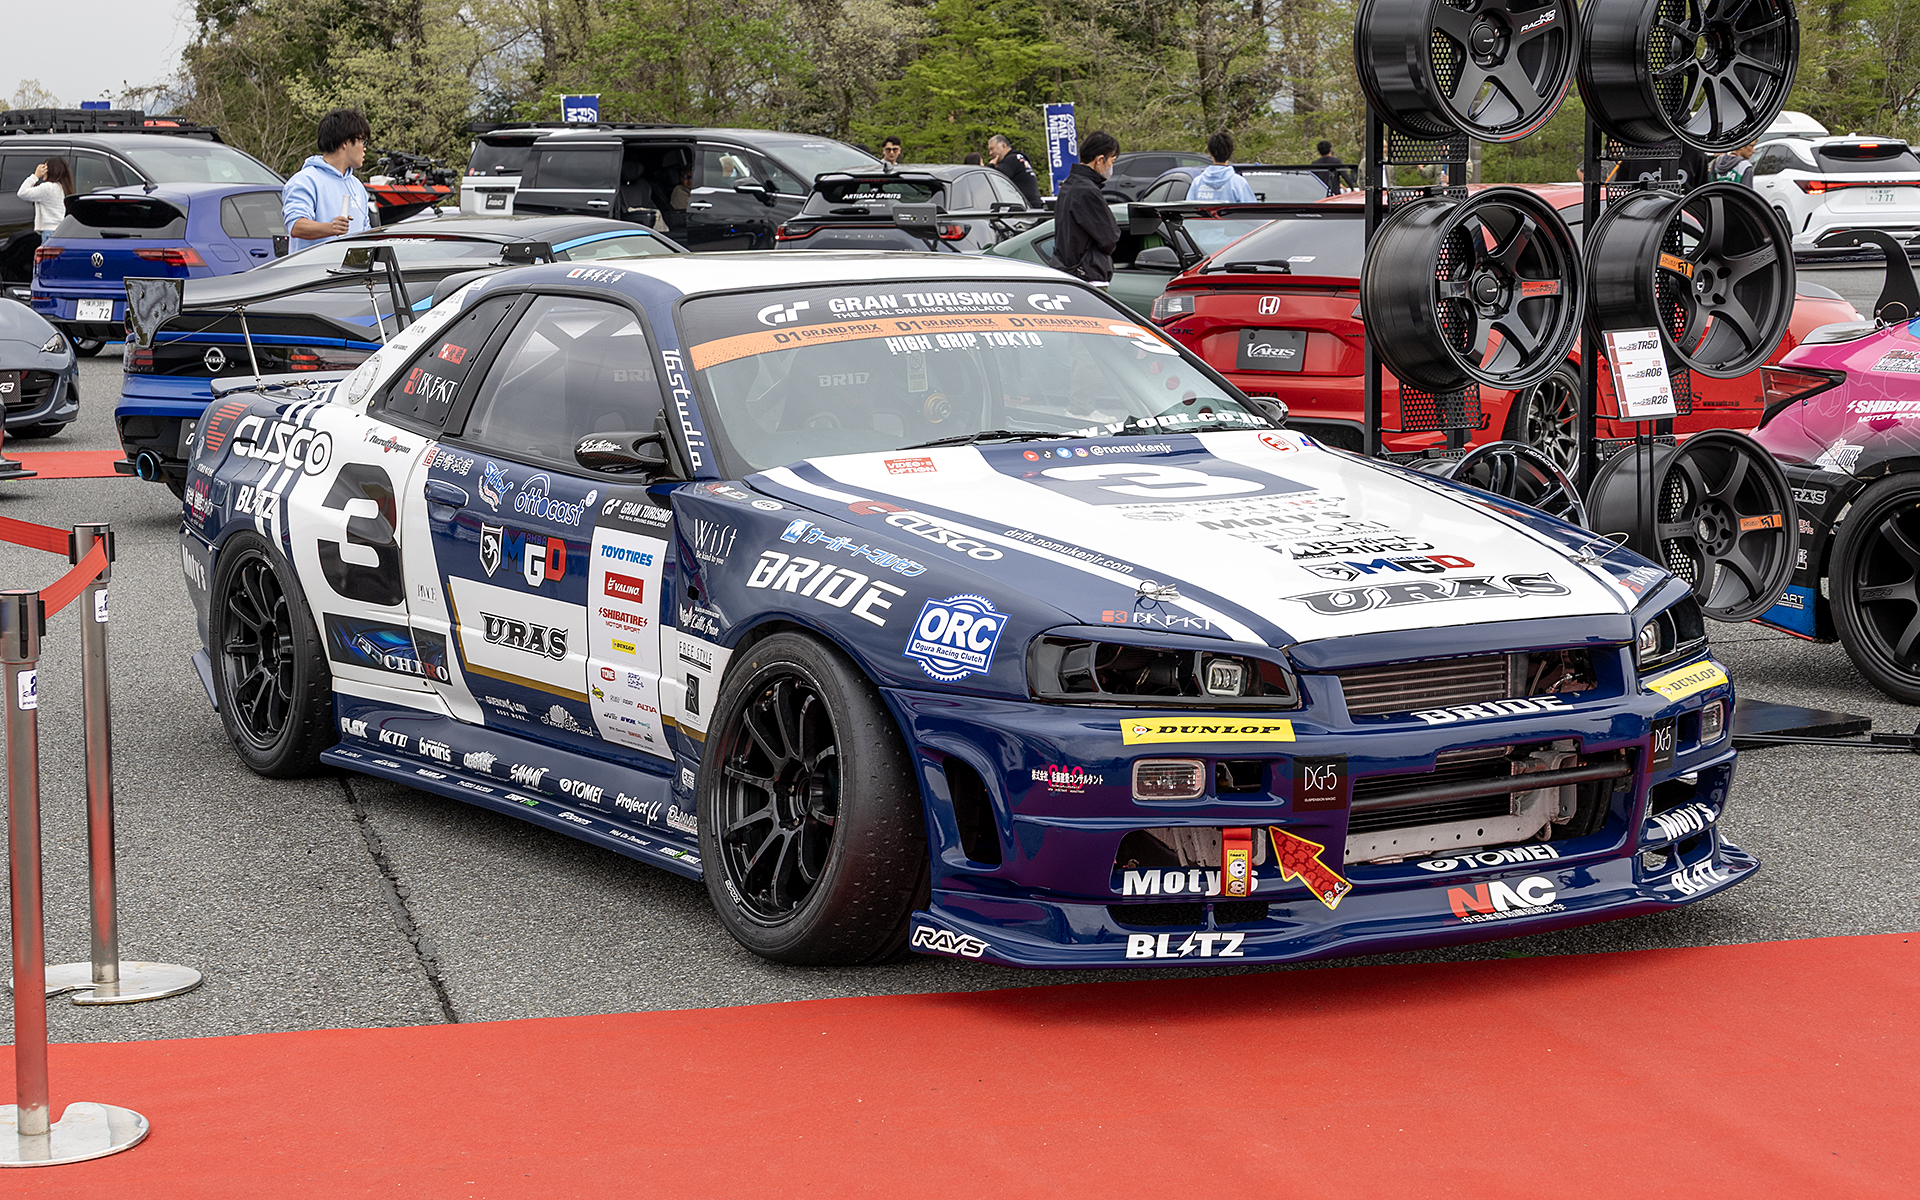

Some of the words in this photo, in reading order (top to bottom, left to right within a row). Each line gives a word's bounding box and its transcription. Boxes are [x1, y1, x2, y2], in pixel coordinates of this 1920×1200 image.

[1058, 114, 1067, 139] FAN
[1066, 112, 1078, 156] RAYS
[1048, 114, 1062, 168] MEETING
[1197, 191, 1214, 199] FAN
[828, 295, 898, 313] GRAN
[901, 291, 1009, 310] TURISMO
[895, 307, 945, 316] DRIVING
[945, 305, 1014, 315] SIMULATOR
[773, 331, 802, 344] D1
[802, 324, 847, 338] GRAND
[847, 322, 881, 333] PRIX
[895, 319, 922, 332] D1
[922, 318, 964, 328] GRAND
[965, 317, 997, 326] PRIX
[1008, 317, 1035, 329] D1
[1034, 317, 1072, 327] GRAND
[1072, 319, 1101, 327] PRIX
[1171, 327, 1194, 335] CIVIC
[884, 335, 934, 353] HIGH
[935, 332, 978, 350] GRIP
[980, 332, 1043, 348] TOKYO
[1246, 342, 1297, 358] VARIS
[1638, 340, 1659, 350] TR50
[1646, 367, 1663, 378] R06
[1651, 394, 1669, 405] R26
[1857, 413, 1892, 424] MOTOR
[233, 414, 334, 477] CUSCO
[1089, 443, 1173, 457] @nomukenjr
[889, 465, 936, 475] OPTION
[1040, 462, 1267, 499] 3
[234, 484, 281, 520] BLITZ
[514, 486, 586, 527] ottocast
[620, 501, 643, 517] GRAN
[640, 504, 674, 523] TURISMO
[1196, 512, 1350, 530] Moty's
[1227, 520, 1390, 540] MIDORI
[317, 461, 405, 607] 3
[884, 511, 1005, 561] CUSCO
[601, 544, 625, 561] TOYO
[626, 550, 654, 567] TIRES
[702, 551, 712, 563] kind
[716, 557, 725, 567] you
[1003, 528, 1135, 575] drift-nomukenjr.com
[614, 582, 640, 596] VALINO
[745, 549, 908, 628] BRIDE
[1278, 573, 1571, 616] URAS
[479, 611, 569, 662] URAS
[605, 621, 623, 629] MOTOR
[623, 624, 641, 634] SPORT
[919, 607, 997, 652] ORC
[617, 643, 635, 651] DUNLOP
[679, 641, 694, 658] FREE
[696, 647, 713, 666] STYLE
[915, 642, 935, 653] Ogura
[935, 646, 960, 660] Racing
[960, 652, 984, 664] Clutch
[383, 654, 449, 682] CHIRO
[602, 669, 616, 680] TONE
[1668, 668, 1717, 692] DUNLOP
[637, 703, 658, 714] ALTIA
[1410, 696, 1575, 725] BRIDE
[341, 717, 369, 739] FLEX
[1156, 725, 1282, 734] DUNLOP
[418, 737, 452, 763] brains
[571, 779, 605, 803] TOMEI
[1651, 802, 1716, 842] Moty's
[1455, 844, 1560, 869] TOMEI
[1671, 858, 1730, 896] BLITZ
[1447, 876, 1558, 918] NAC
[911, 926, 991, 957] RAYS
[1125, 930, 1247, 959] BLITZ
